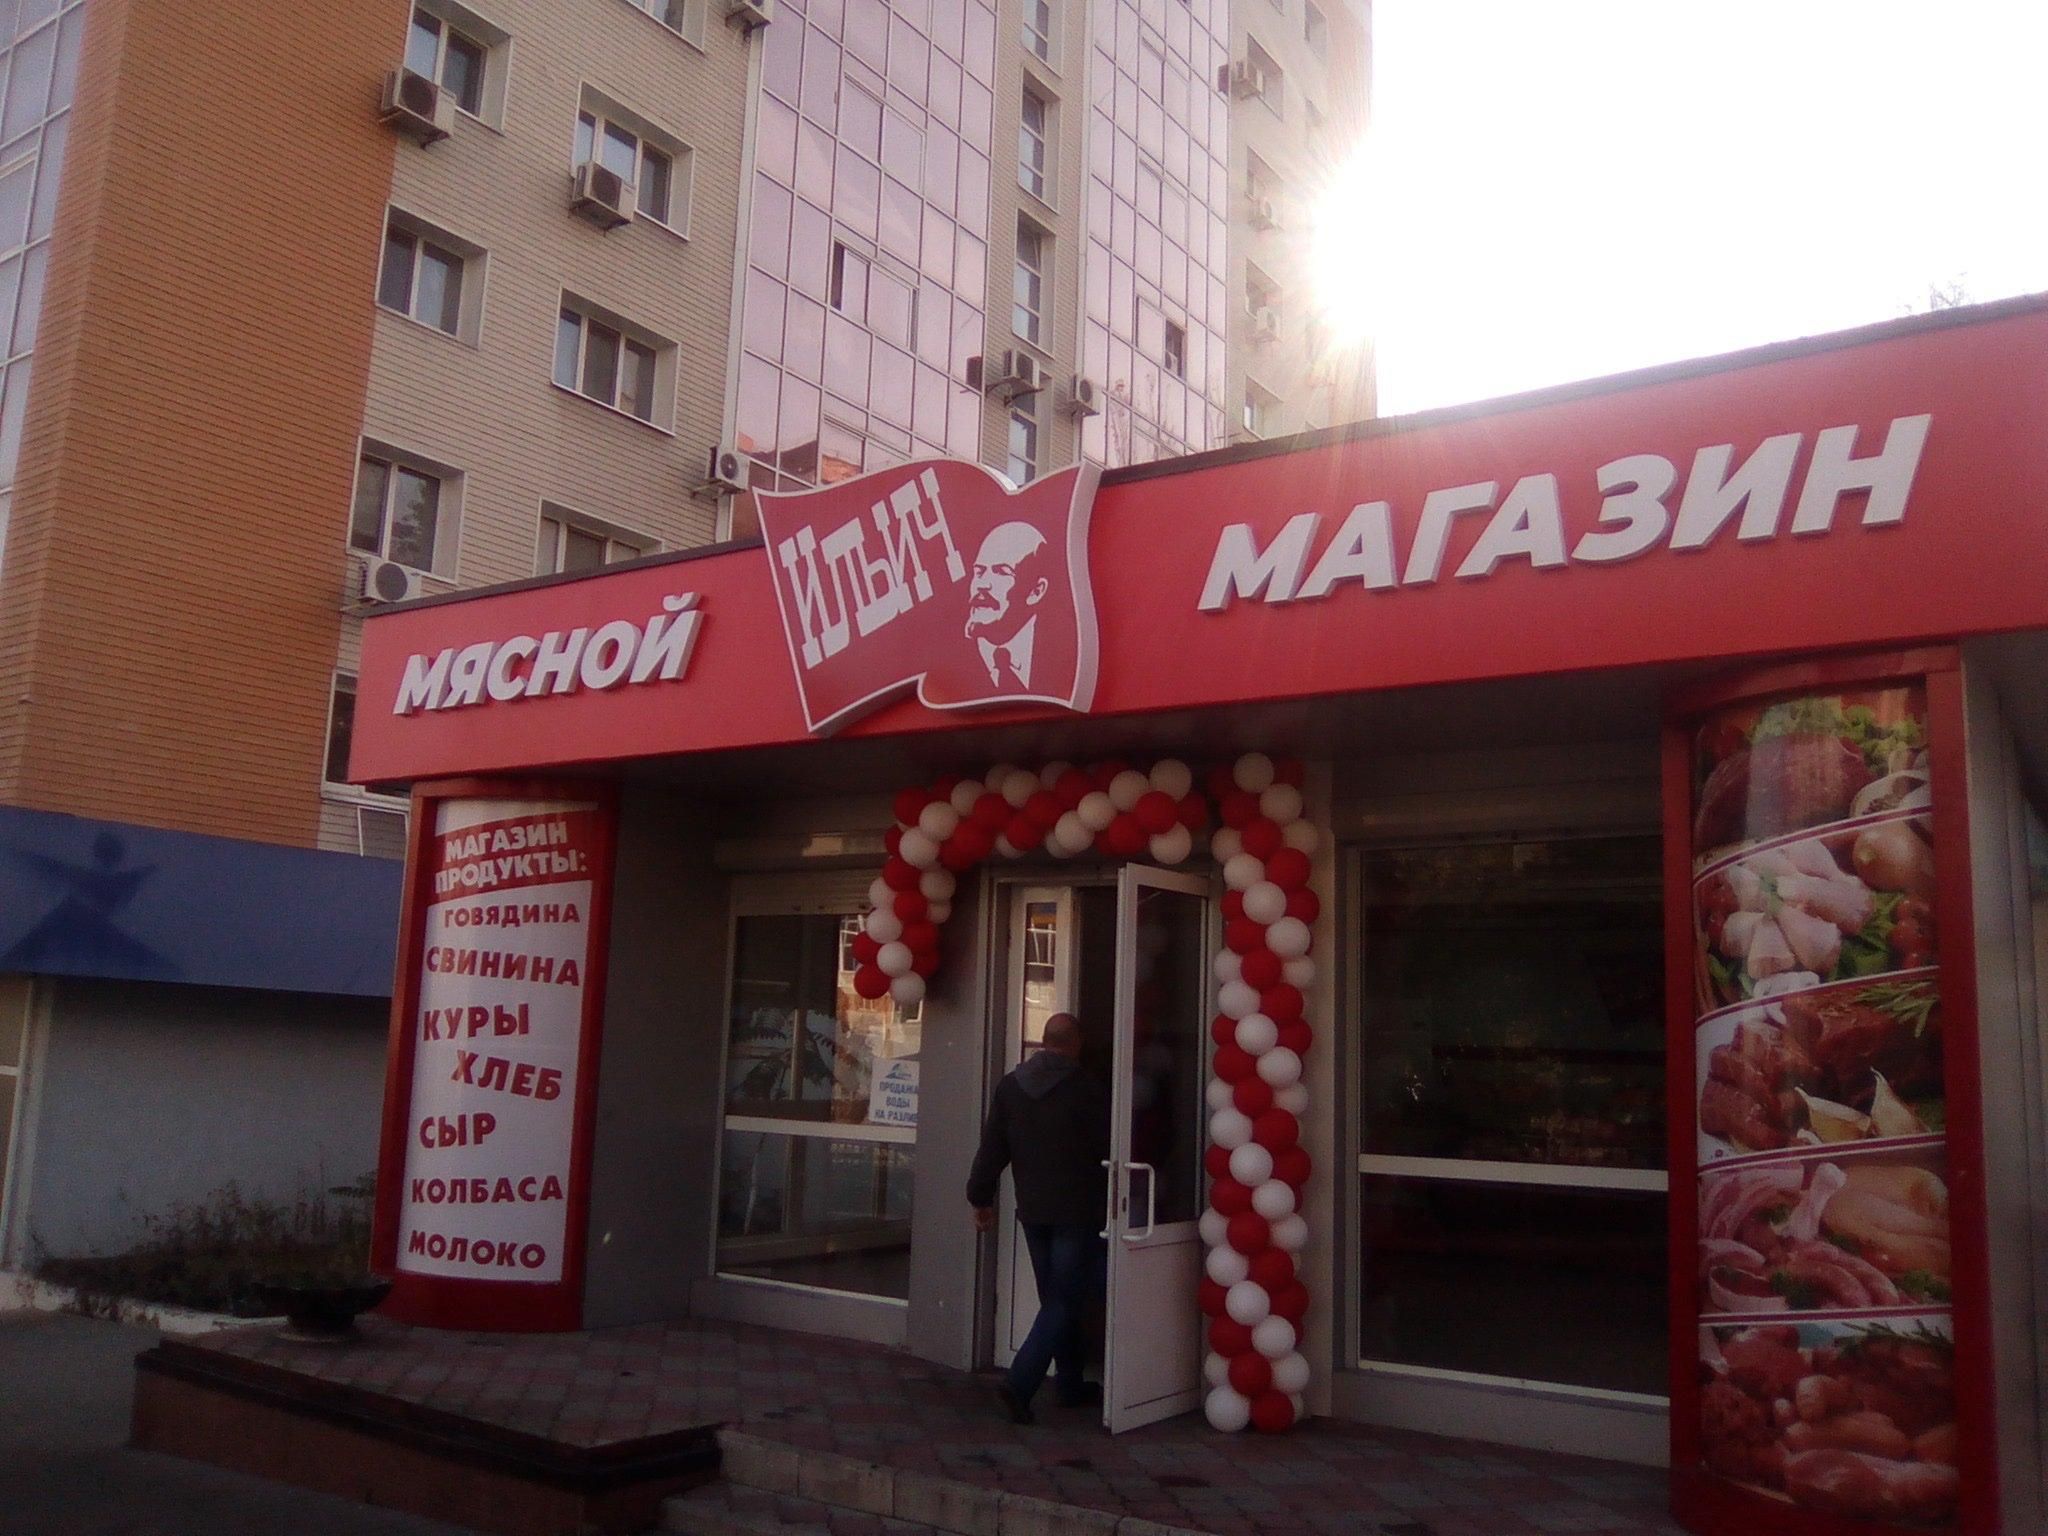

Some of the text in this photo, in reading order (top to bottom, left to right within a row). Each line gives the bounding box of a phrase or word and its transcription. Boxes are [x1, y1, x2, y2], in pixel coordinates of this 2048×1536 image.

[392, 413, 1934, 715] МЯСНОЙ МАГАЗИН
[777, 466, 966, 670] ИЛЬИЧ
[445, 820, 568, 863] МАГАЗИН
[435, 850, 589, 894] ПРОДУКТЫ:
[444, 902, 581, 928] ГОВЯДИНА
[426, 945, 580, 987] СВИНИНА
[423, 1003, 531, 1041] КУРЫ
[451, 1049, 563, 1101] ХЛЕБ
[886, 1096, 911, 1108] ВОДЫ
[419, 1112, 497, 1149] СЫР
[411, 1174, 565, 1204] КОЛБАСА
[408, 1229, 546, 1269] МОЛОКО
